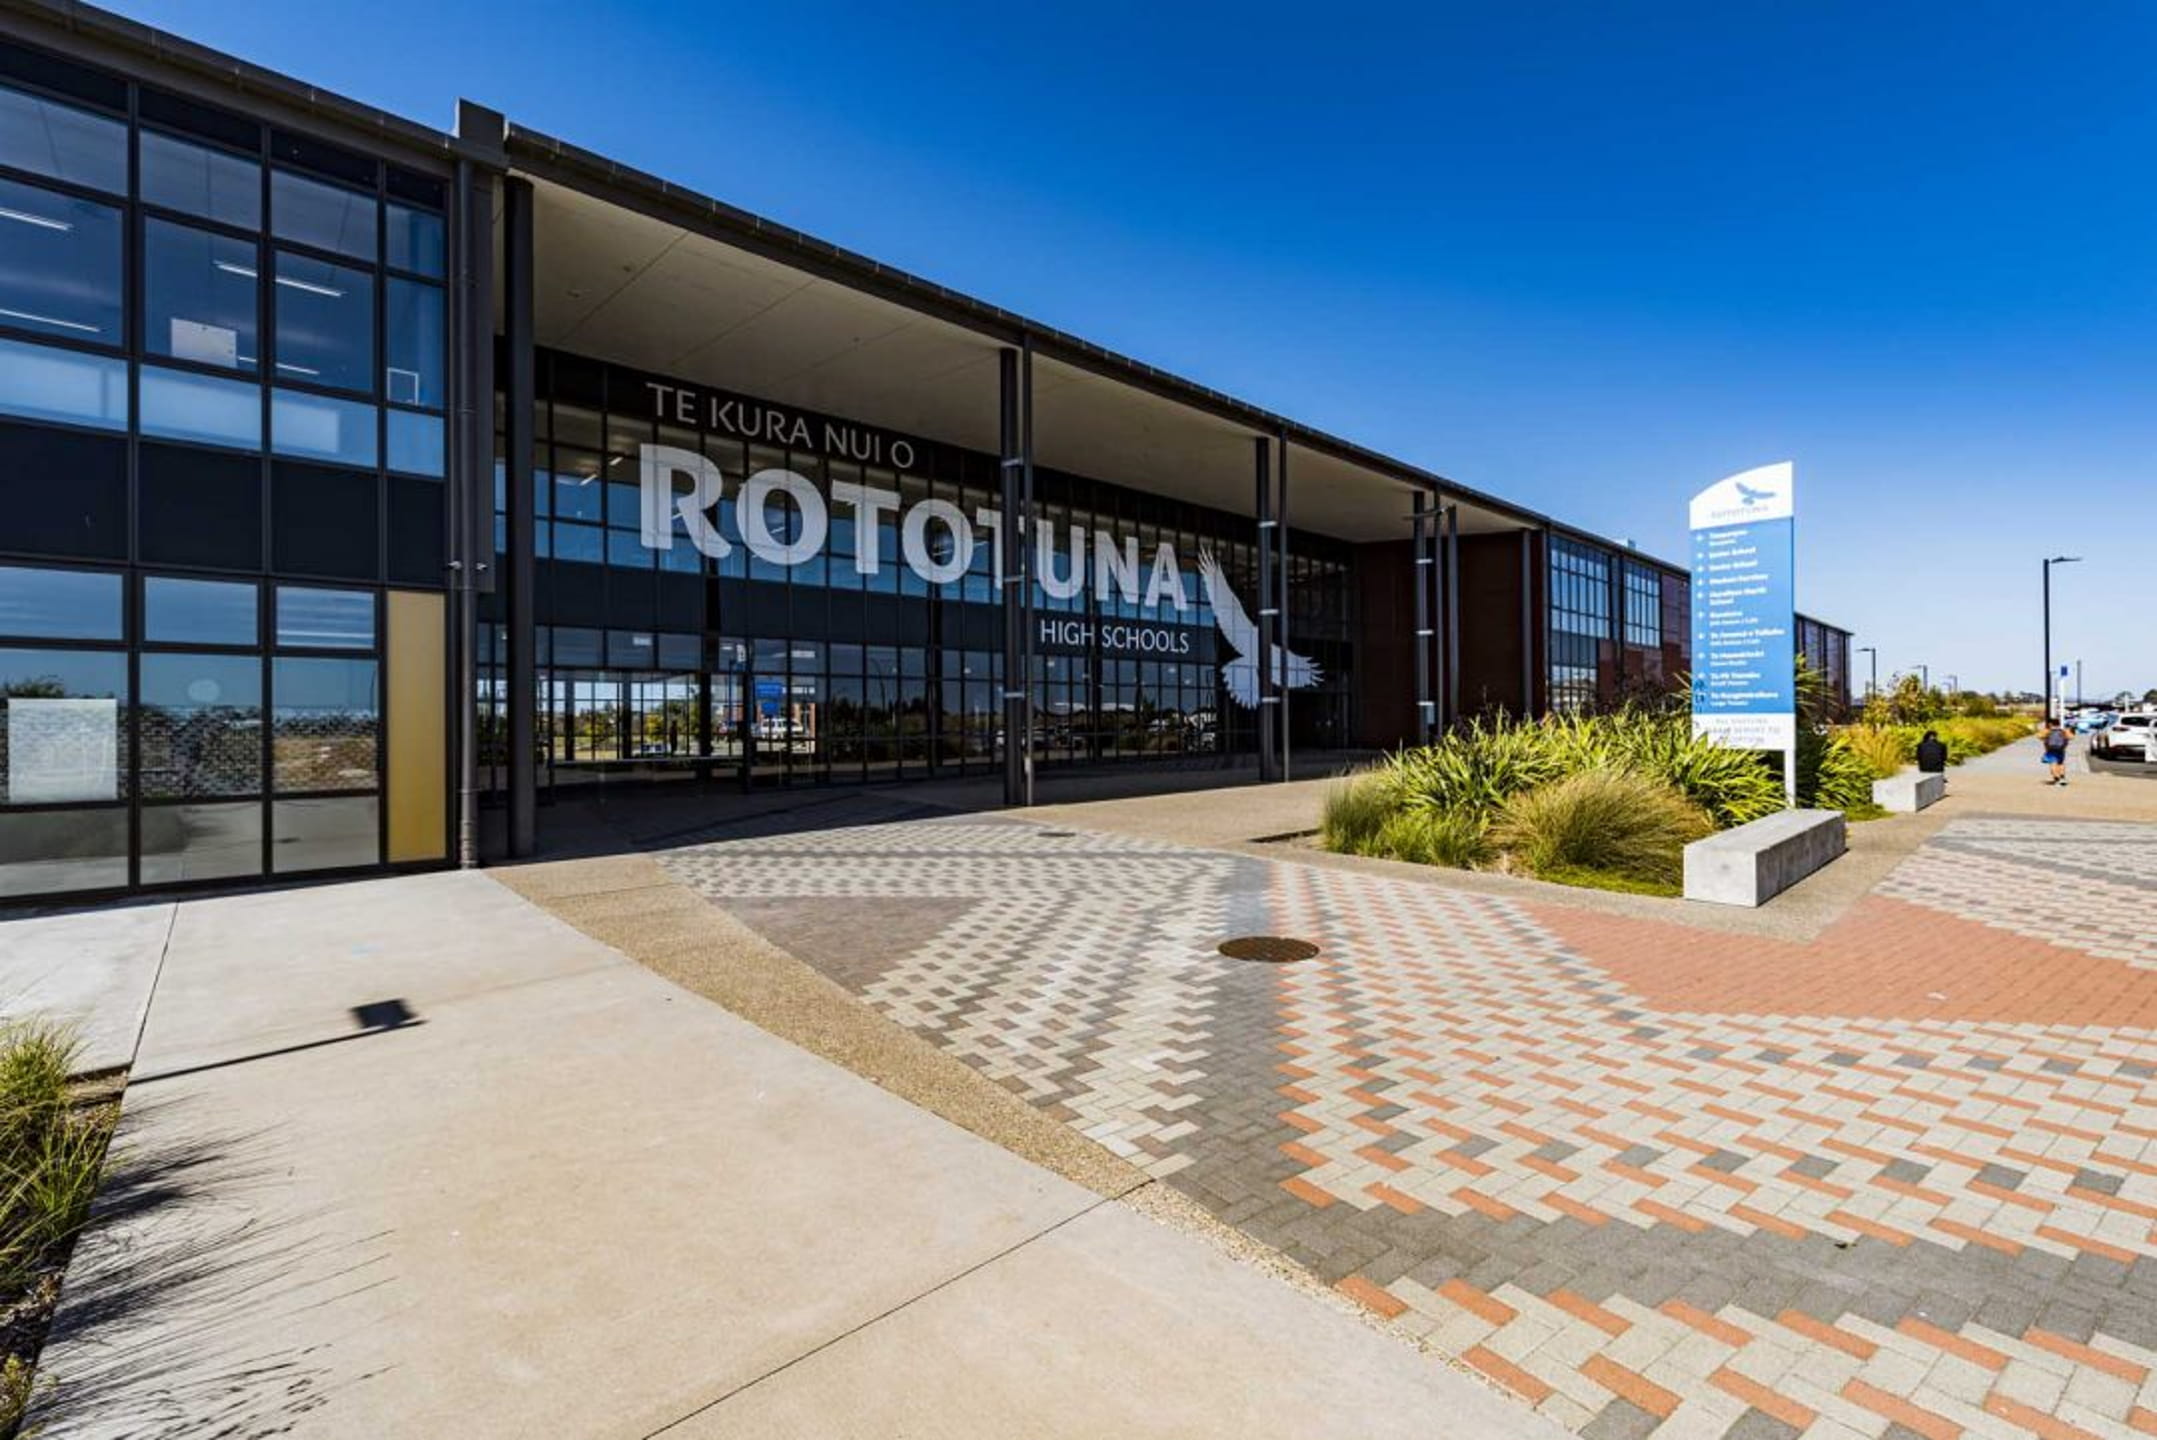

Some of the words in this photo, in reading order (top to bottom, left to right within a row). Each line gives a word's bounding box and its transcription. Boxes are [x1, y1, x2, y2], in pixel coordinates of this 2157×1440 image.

[646, 382, 697, 425] TE
[710, 397, 812, 448] KURA
[825, 423, 880, 463] NUI
[891, 440, 915, 469] O
[1040, 619, 1095, 645] HIGH
[1102, 625, 1189, 654] SCHOOLS
